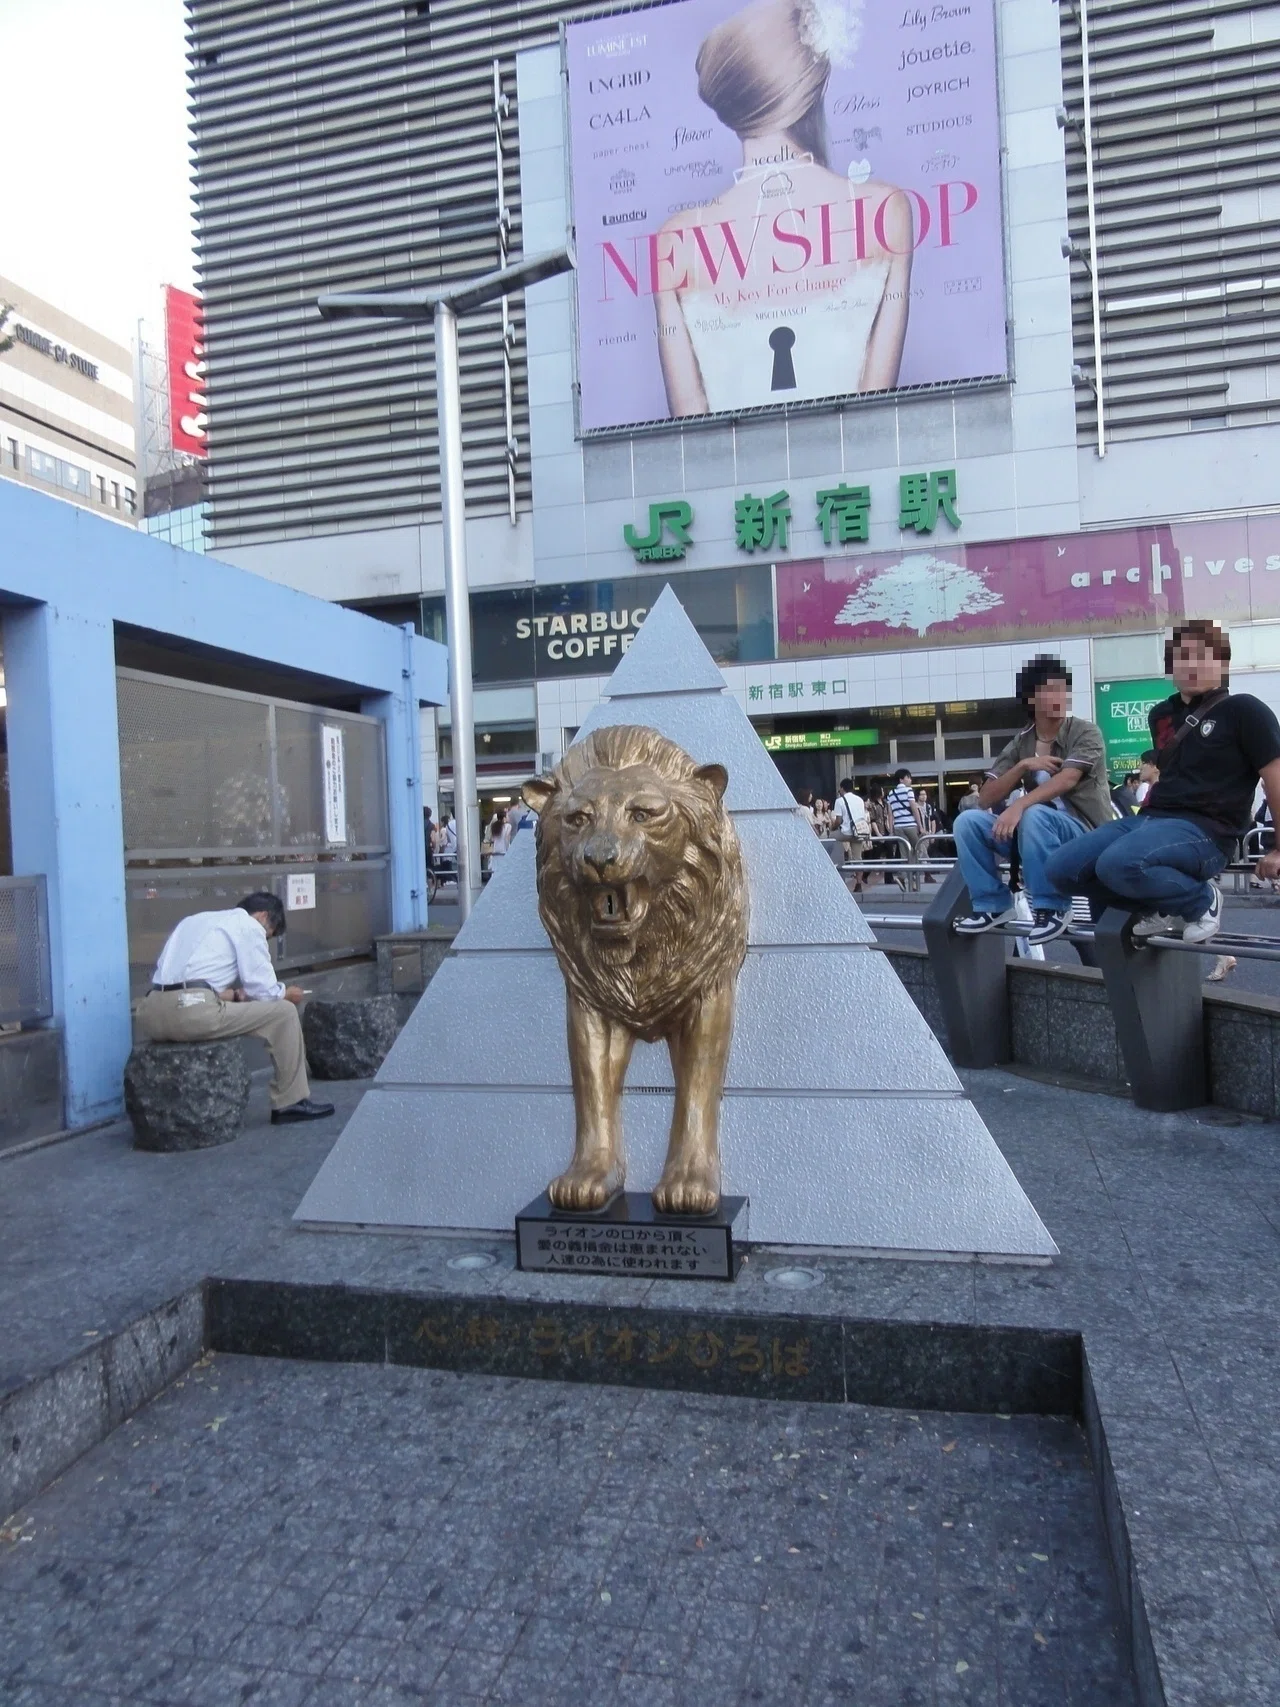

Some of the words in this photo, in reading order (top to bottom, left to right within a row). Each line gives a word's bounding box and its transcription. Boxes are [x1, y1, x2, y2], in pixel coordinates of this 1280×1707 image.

[899, 9, 926, 31] Lily
[931, 4, 971, 23] Brown
[589, 69, 651, 95] UNGRID
[906, 76, 971, 103] JOYRICH
[589, 105, 652, 130] CA4LA
[905, 114, 973, 136] STUDIOUS
[593, 148, 619, 160] paper
[623, 141, 651, 153] chest
[671, 126, 714, 152] flower
[602, 209, 648, 226] Laundry
[595, 214, 767, 303] NEW
[771, 180, 978, 276] SHOP
[714, 292, 732, 309] My
[736, 287, 761, 305] Key
[766, 283, 789, 299] For
[795, 273, 848, 295] Change
[598, 332, 638, 346] rienda
[69, 352, 100, 381] STORE
[623, 500, 694, 550] JR
[735, 469, 962, 553] 新宿駅
[516, 607, 652, 640] STARBUC
[547, 633, 635, 660] COFFE
